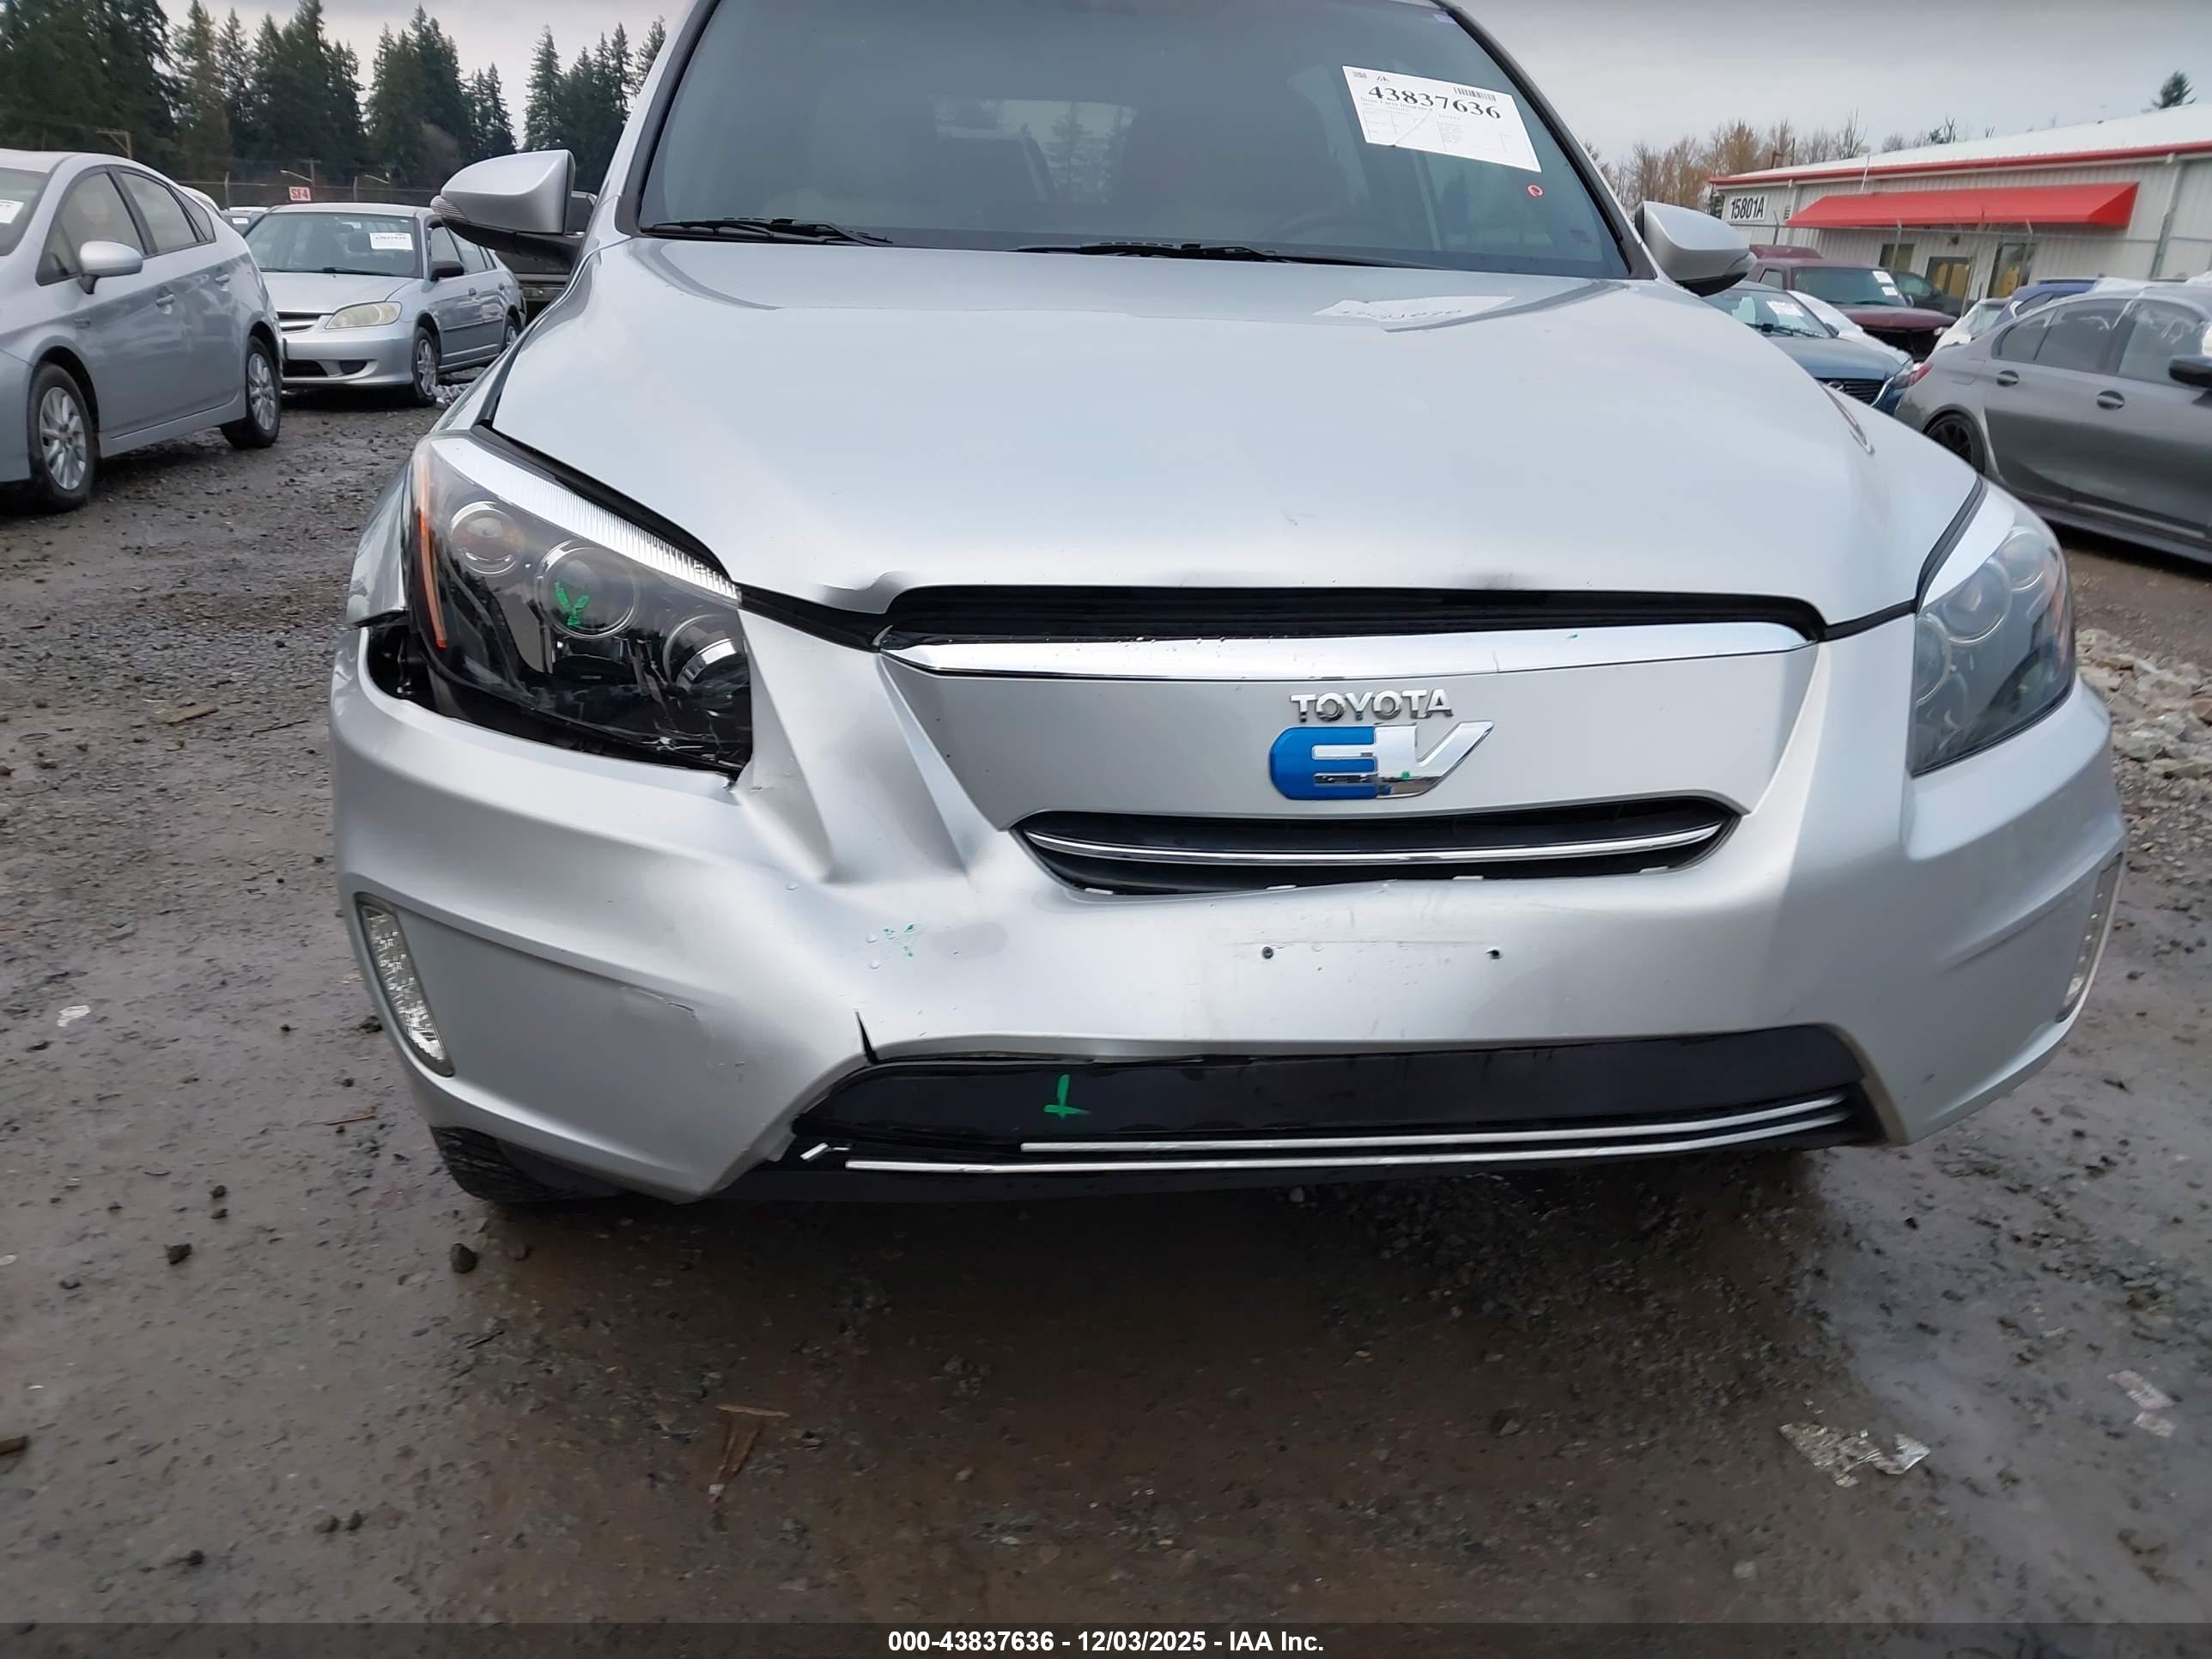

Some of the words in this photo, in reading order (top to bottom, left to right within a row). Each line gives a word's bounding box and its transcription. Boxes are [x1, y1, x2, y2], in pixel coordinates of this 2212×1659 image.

[1368, 86, 1501, 118] 43837636
[1731, 197, 1765, 219] 15801A
[1291, 689, 1455, 722] TOYOTA
[1269, 720, 1495, 800] EV
